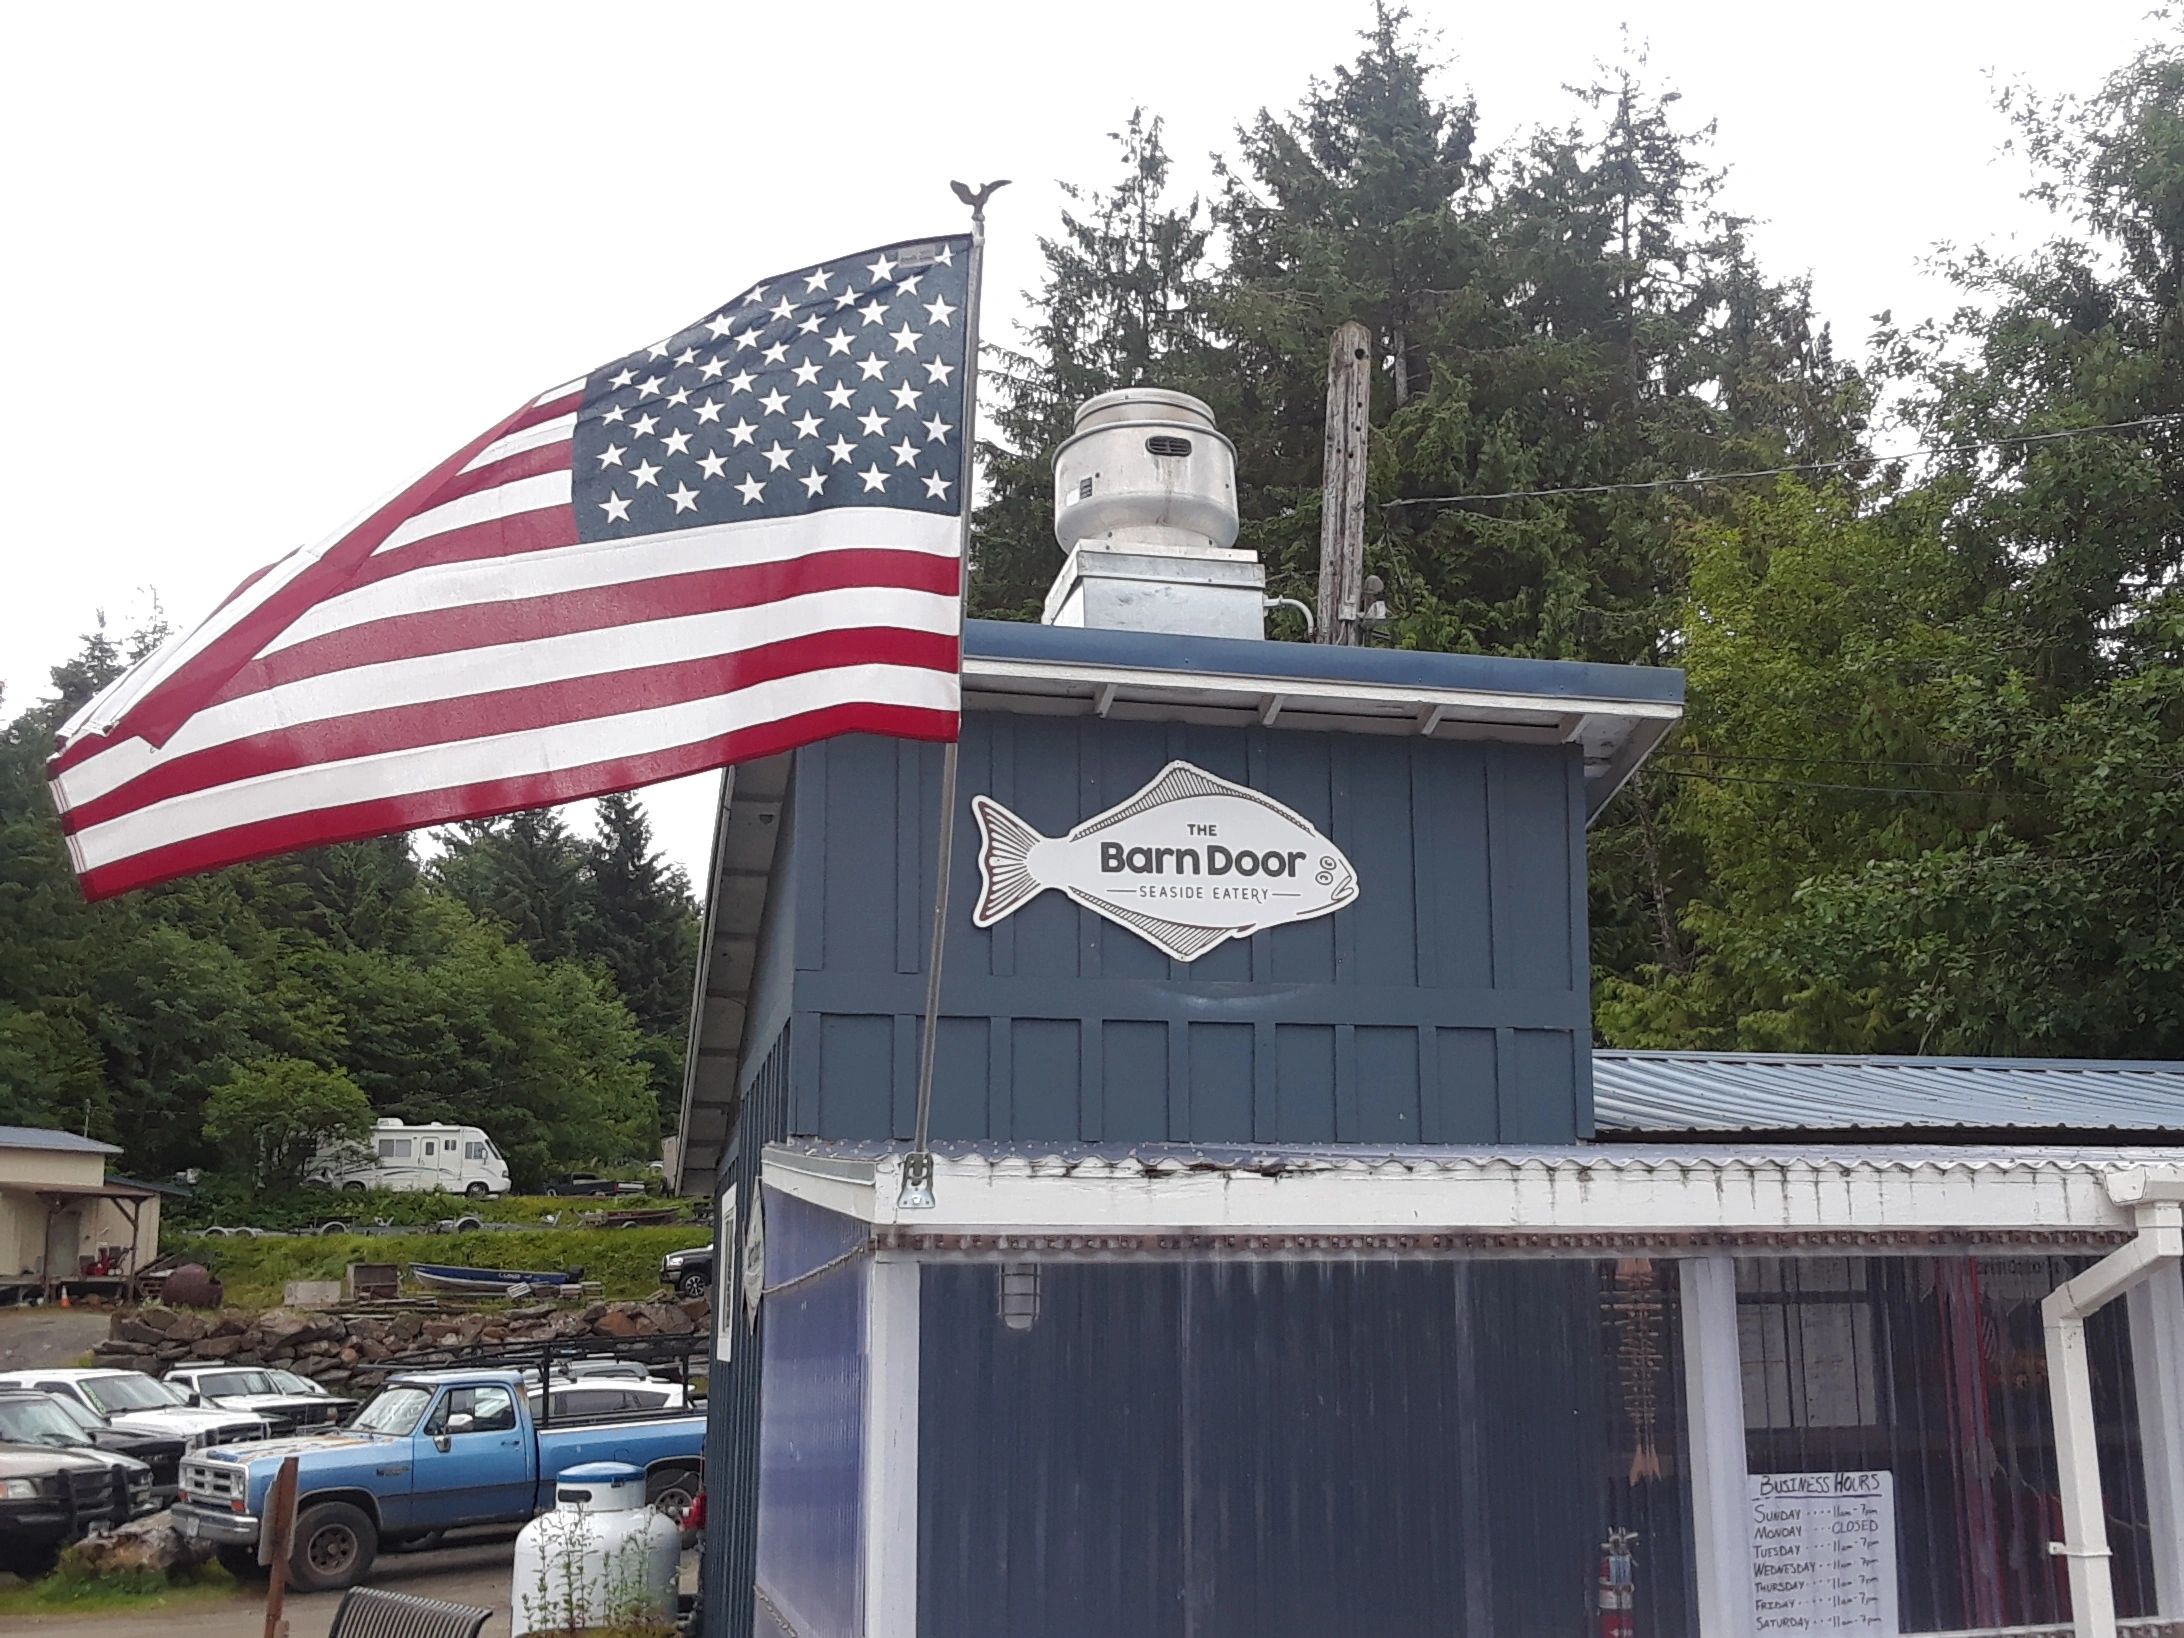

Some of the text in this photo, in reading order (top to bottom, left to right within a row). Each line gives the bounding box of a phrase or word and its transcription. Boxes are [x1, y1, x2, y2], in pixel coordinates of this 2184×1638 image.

[1187, 823, 1217, 837] THE
[1100, 841, 1307, 878] Barn Door
[1139, 885, 1269, 904] SEASIDE EATERY
[1759, 1473, 1880, 1496] BUSINESS HOURS
[1753, 1504, 1801, 1523] SUNDAY
[1754, 1520, 1879, 1539] MONDAY CLOSED
[1752, 1545, 1801, 1559] TUESDAY
[1753, 1562, 1816, 1577] WEDNESDAY
[1754, 1581, 1805, 1593] THURSDAY
[1755, 1599, 1795, 1611] FRIDAY
[1756, 1616, 1809, 1631] SATURDAY
